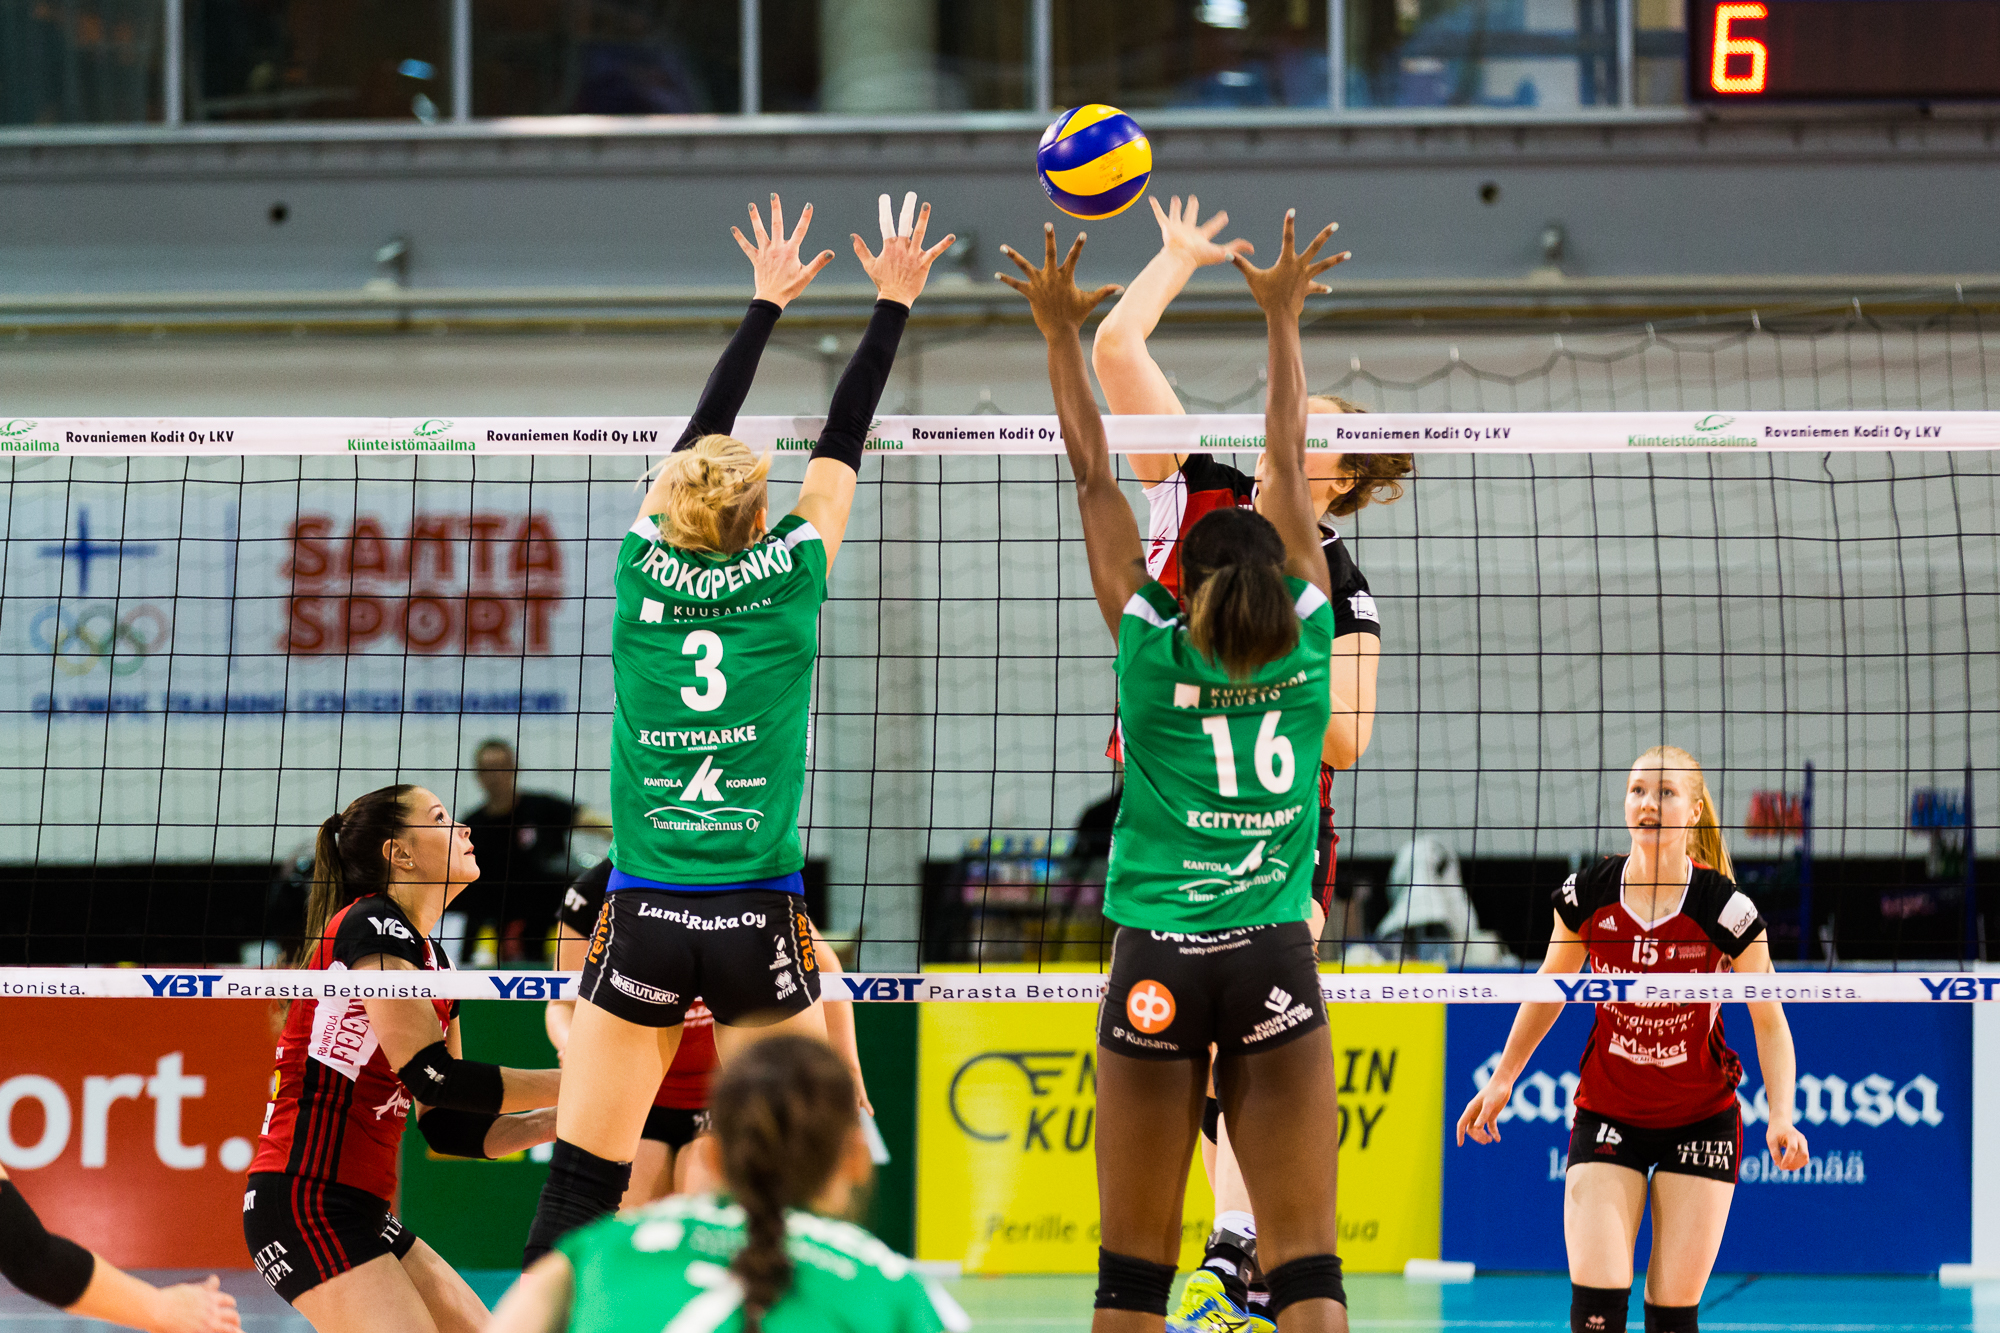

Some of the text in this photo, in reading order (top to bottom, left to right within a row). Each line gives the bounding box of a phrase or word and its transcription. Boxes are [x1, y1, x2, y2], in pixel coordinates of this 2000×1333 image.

[1710, 1, 1769, 93] 6
[66, 430, 235, 445] Rovaniemen Kodit Oy LKV
[486, 429, 658, 444] Rovaniemen Kodit Oy LKV
[912, 428, 995, 440] Rovaniemen
[999, 428, 1034, 440] Kodit
[1038, 428, 1055, 442] Oy
[1336, 427, 1511, 442] Rovaniemen Kodit Oy LKV
[1628, 435, 1757, 448] Kiinteistömaailma
[1765, 426, 1942, 440] Rovaniemen Kodit Oy LKV
[347, 438, 476, 451] Kiinteistömaailma
[278, 587, 565, 658] SPORT
[680, 629, 727, 712] 3
[1202, 710, 1296, 797] 16
[643, 777, 683, 788] KANTOLA
[726, 777, 767, 788] KORAMO
[650, 816, 760, 832] Tunturirakennus Oy
[1182, 859, 1231, 873] KANTOLA
[741, 911, 767, 928] Oy
[1632, 935, 1659, 966] 15
[141, 974, 437, 998] YBT Parasta Betonista.
[488, 976, 571, 1000] YBT
[841, 977, 925, 1001] YBT
[930, 986, 1016, 999] Parasta
[1382, 986, 1498, 999] Betonista.
[1553, 979, 1861, 1002] YBT Parasta Betonista.
[1919, 977, 2000, 1001] YBT
[1595, 1122, 1623, 1145] 15
[1678, 1150, 1730, 1170] TUPA
